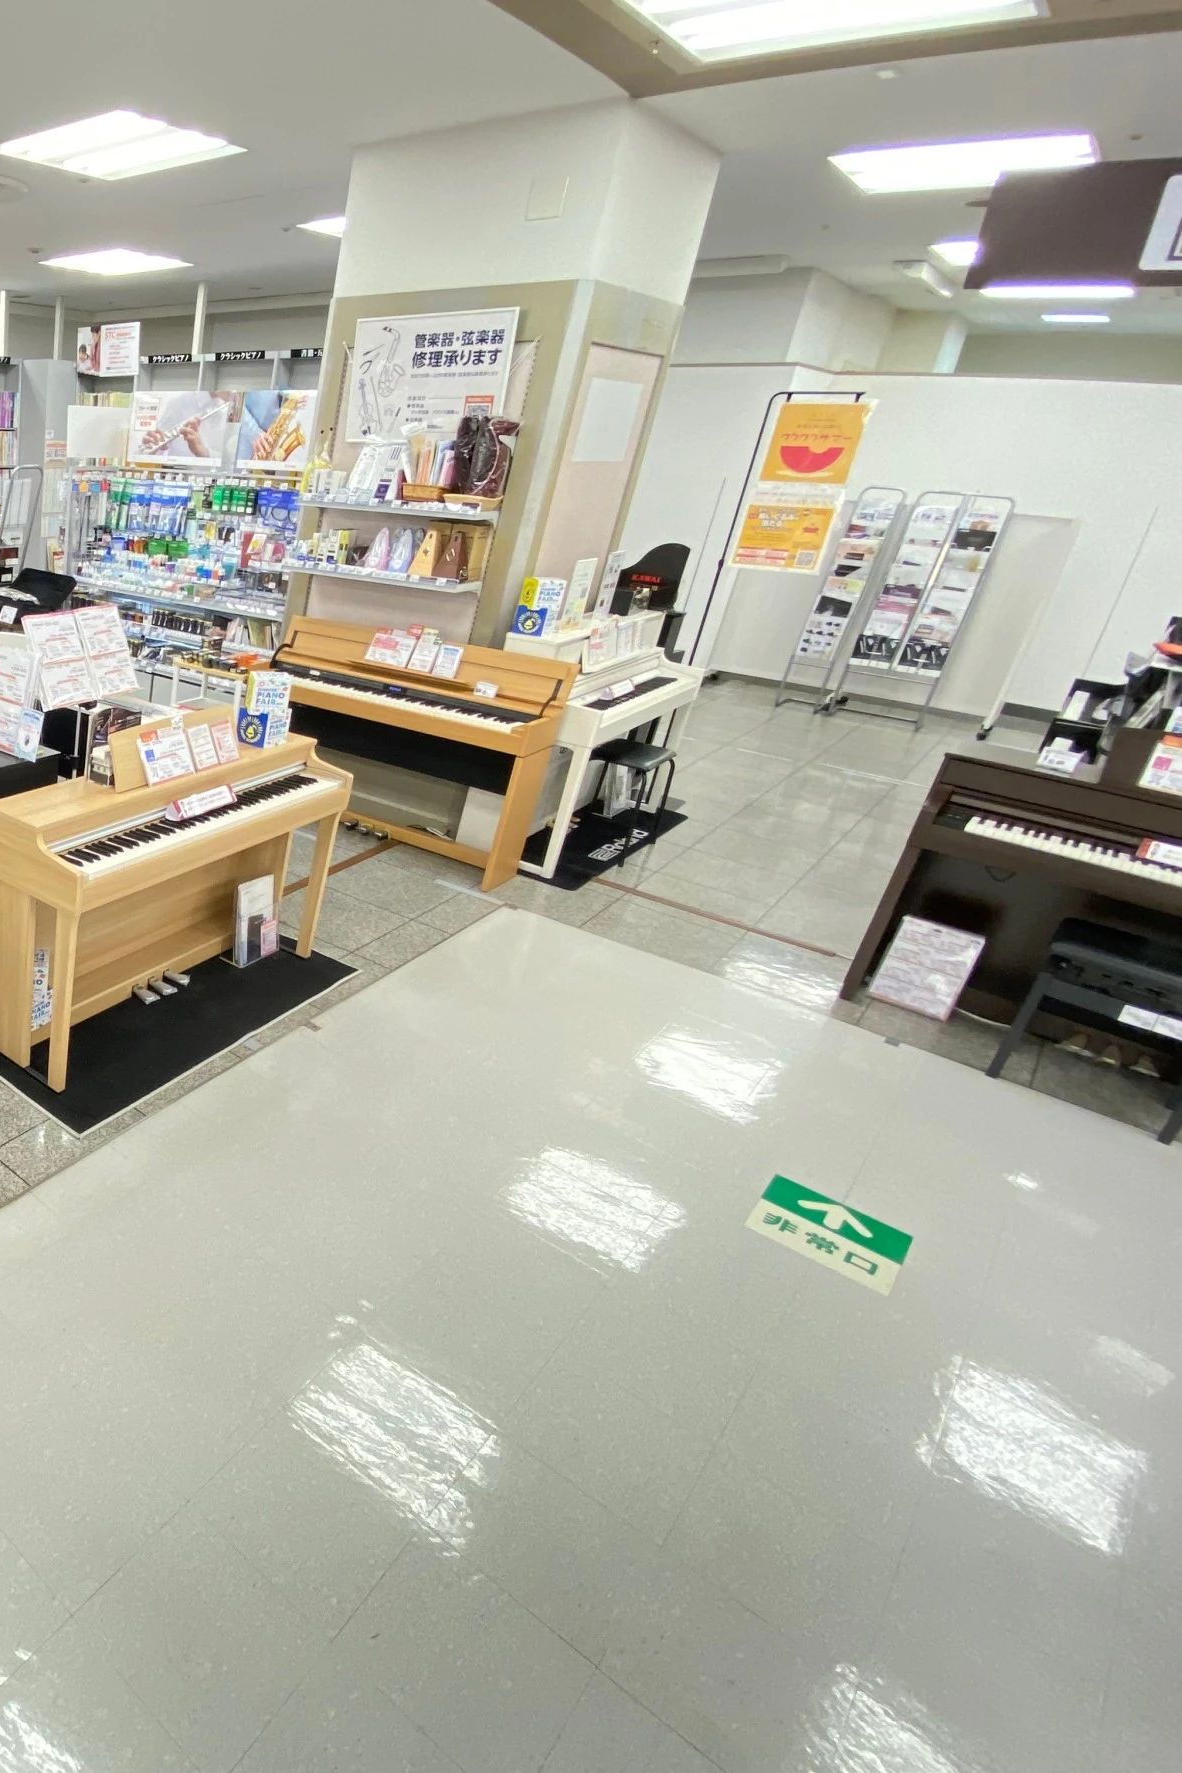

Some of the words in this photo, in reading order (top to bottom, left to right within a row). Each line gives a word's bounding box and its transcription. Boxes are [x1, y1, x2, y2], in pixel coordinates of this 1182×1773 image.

[415, 329, 505, 348] 管楽器・弦楽器
[152, 354, 189, 363] クラシックピアノ
[220, 351, 261, 360] クラシックピアノ
[412, 349, 502, 368] 修理承ります
[631, 574, 662, 584] KAWAI
[256, 691, 286, 700] PIANO
[255, 698, 276, 706] FAIR
[270, 722, 287, 731] PIANO
[762, 1212, 878, 1276] 非常口
